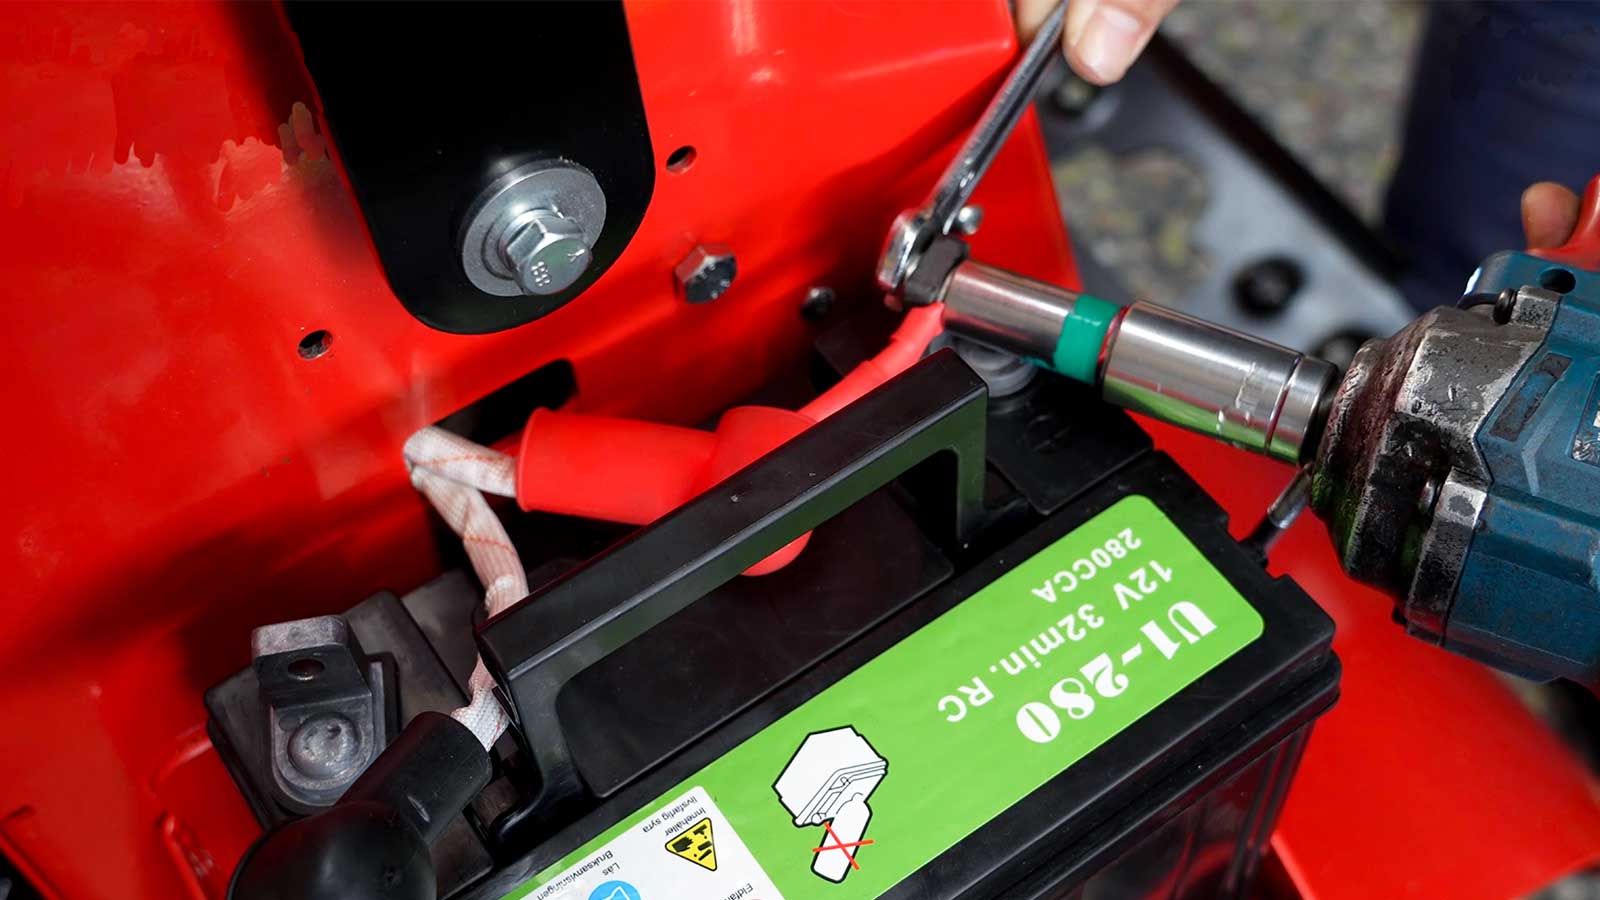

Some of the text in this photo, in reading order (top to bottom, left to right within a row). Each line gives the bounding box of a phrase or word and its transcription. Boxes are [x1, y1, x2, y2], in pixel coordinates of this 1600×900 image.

[1031, 527, 1142, 603] 280CCA
[937, 559, 1173, 723] 12V 32min. RC
[1015, 600, 1218, 744] U1-280
[642, 817, 662, 834] syra
